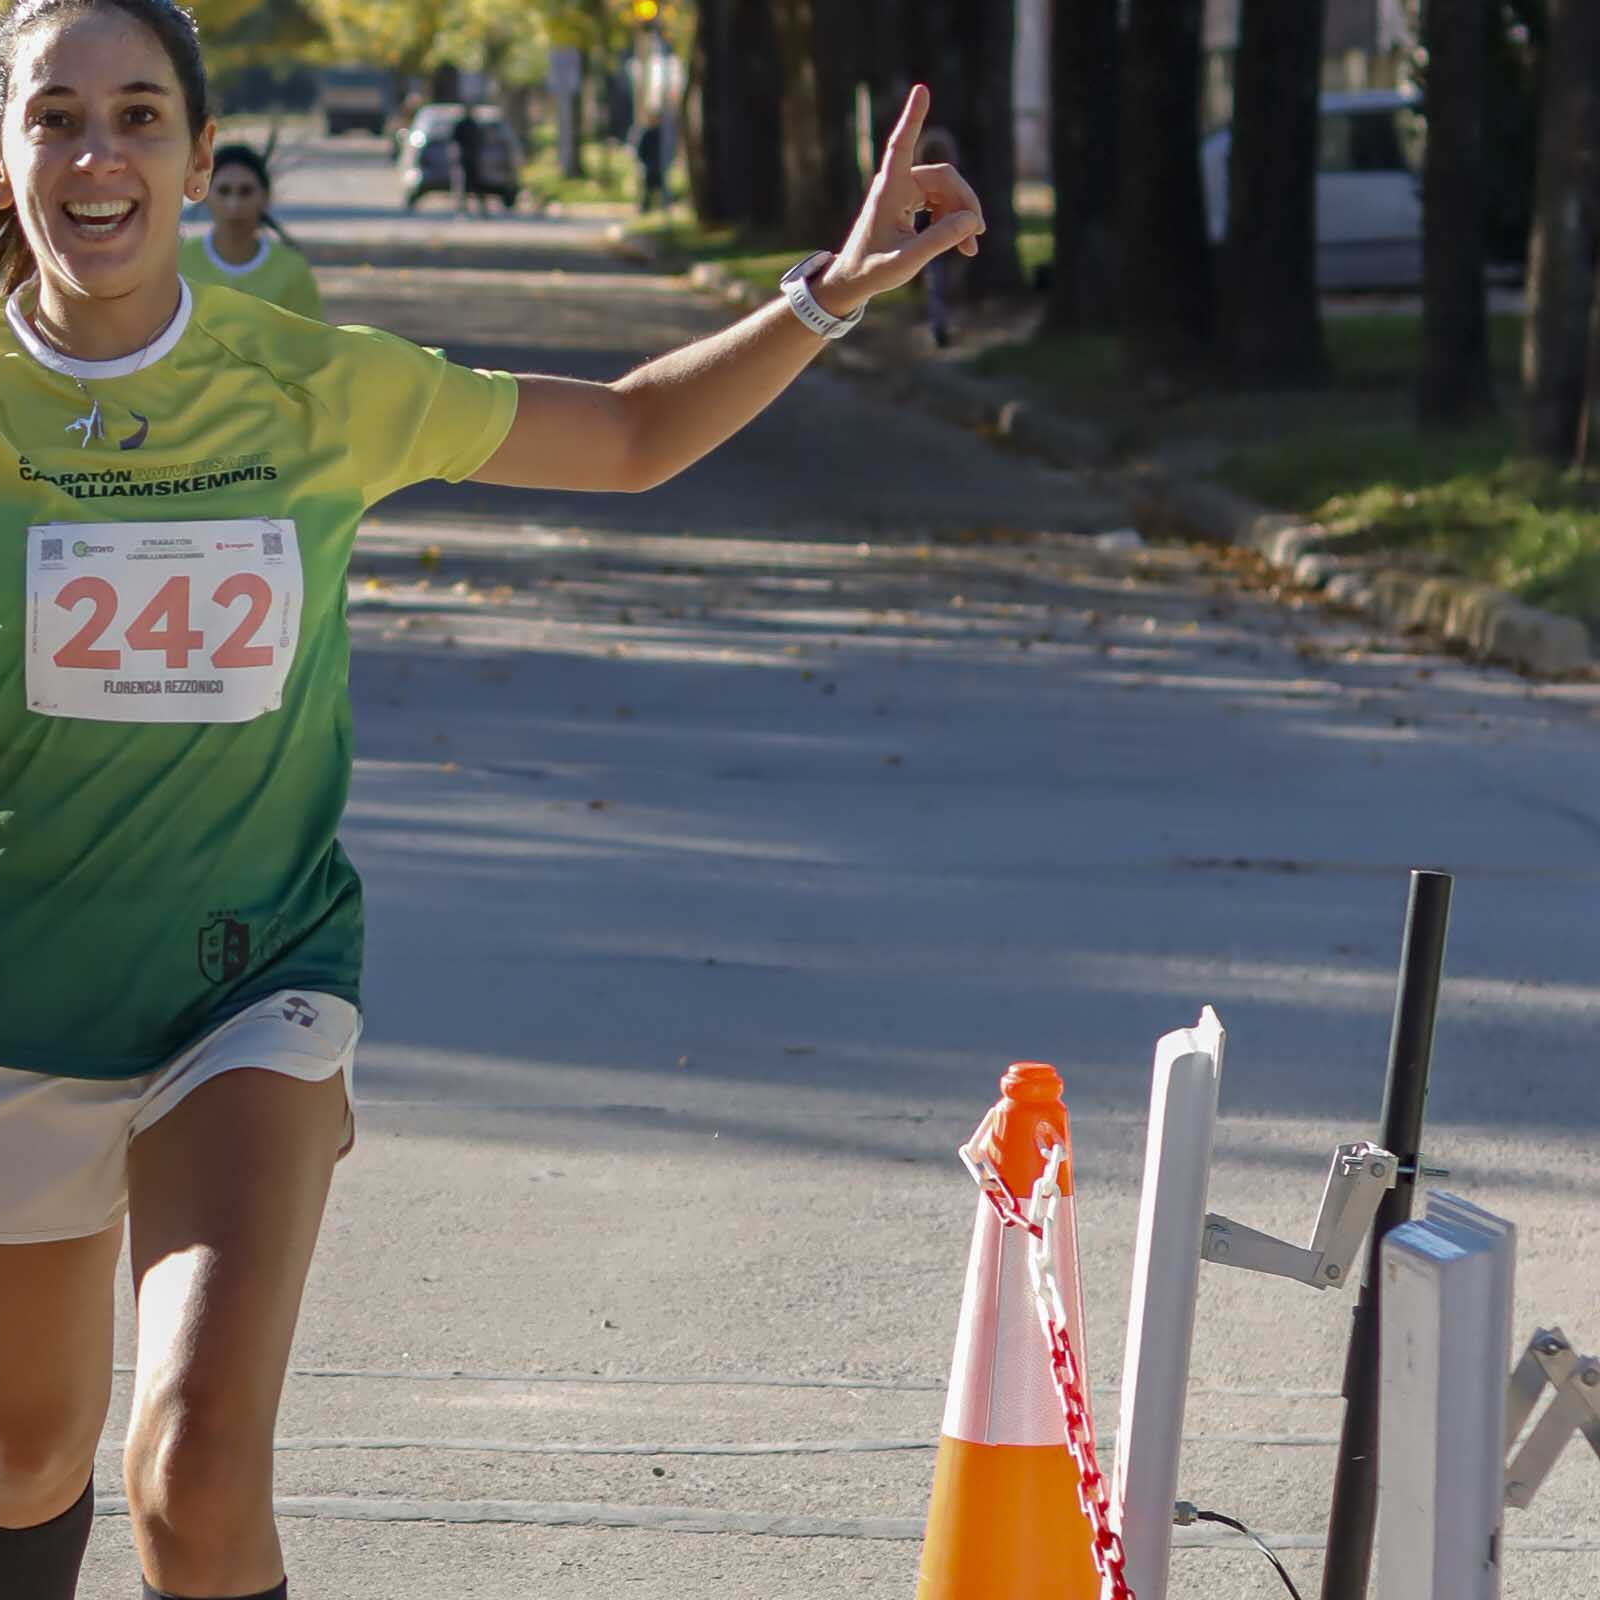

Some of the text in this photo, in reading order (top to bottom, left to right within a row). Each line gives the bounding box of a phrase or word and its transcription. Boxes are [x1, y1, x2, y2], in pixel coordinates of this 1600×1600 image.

[52, 572, 274, 670] 242
[104, 679, 224, 694] FLORENCIA REZZONICO
